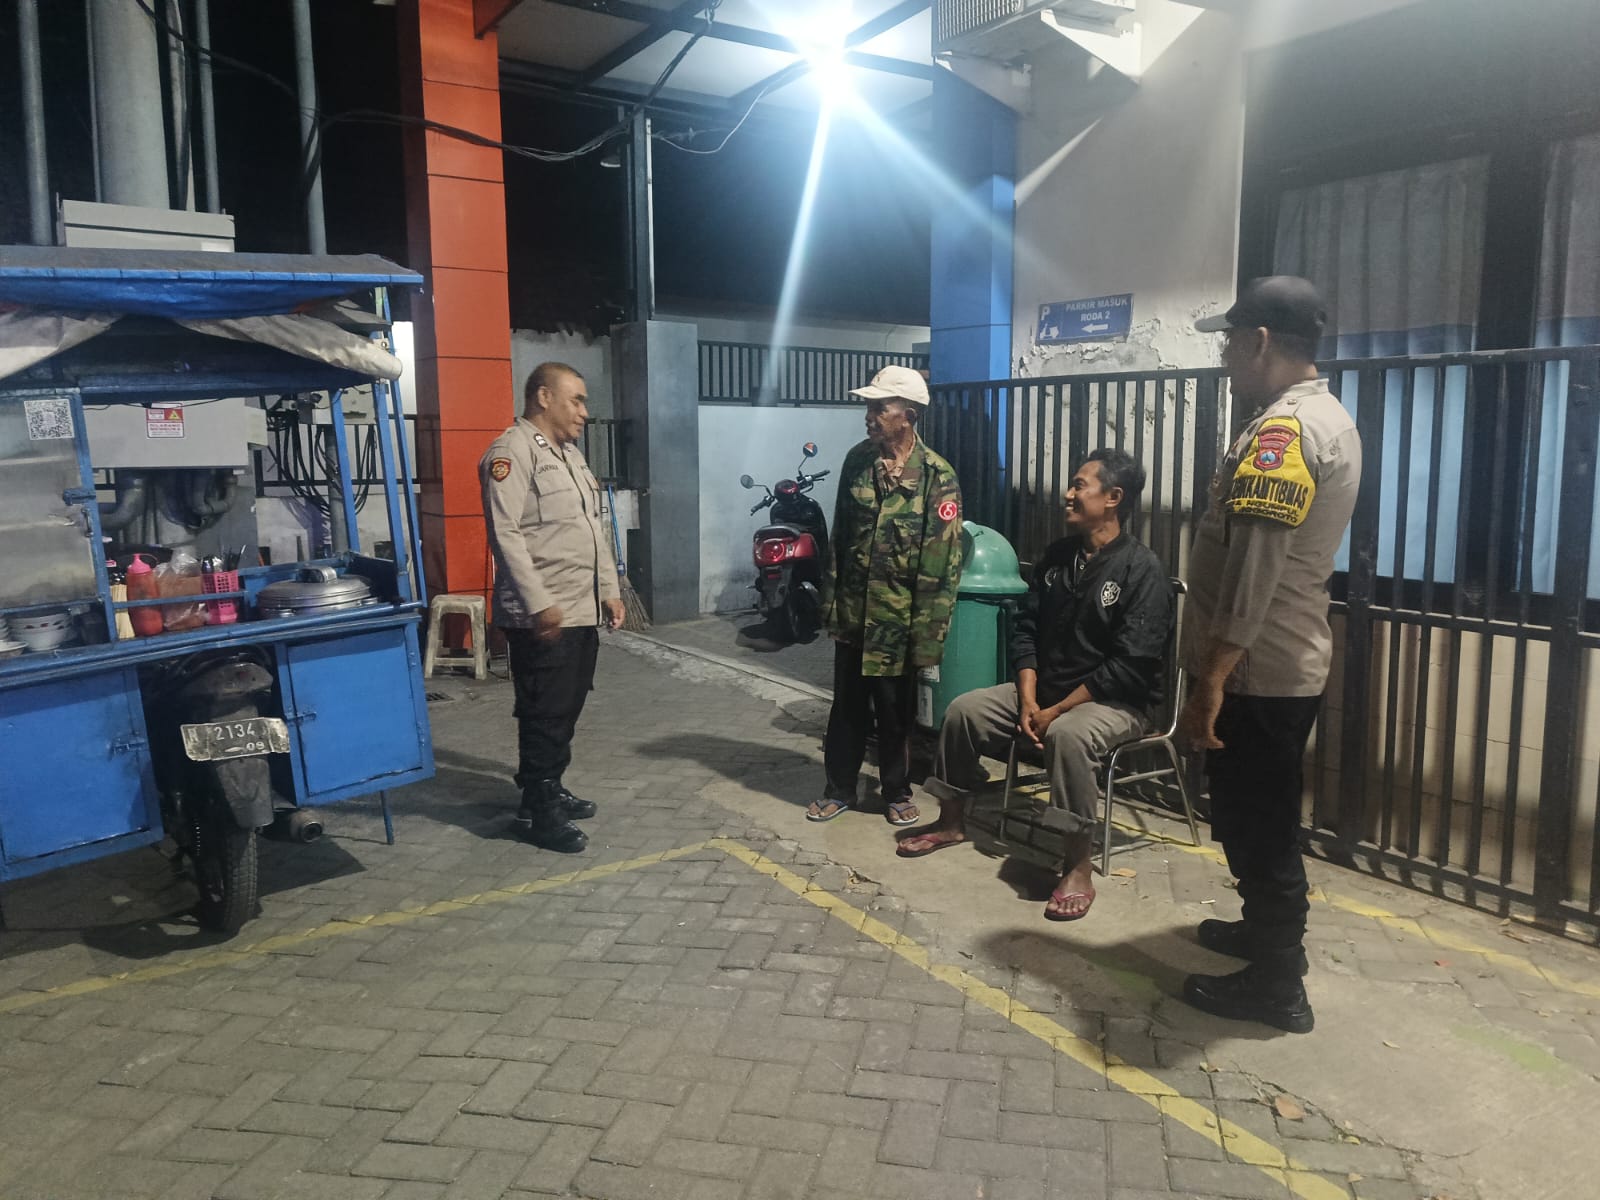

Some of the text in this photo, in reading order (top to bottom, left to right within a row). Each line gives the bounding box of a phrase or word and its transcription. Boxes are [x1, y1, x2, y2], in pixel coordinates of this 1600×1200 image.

[1065, 296, 1128, 312] PARKIR MASUK
[1080, 310, 1111, 322] RODA 2
[213, 722, 255, 740] 2134
